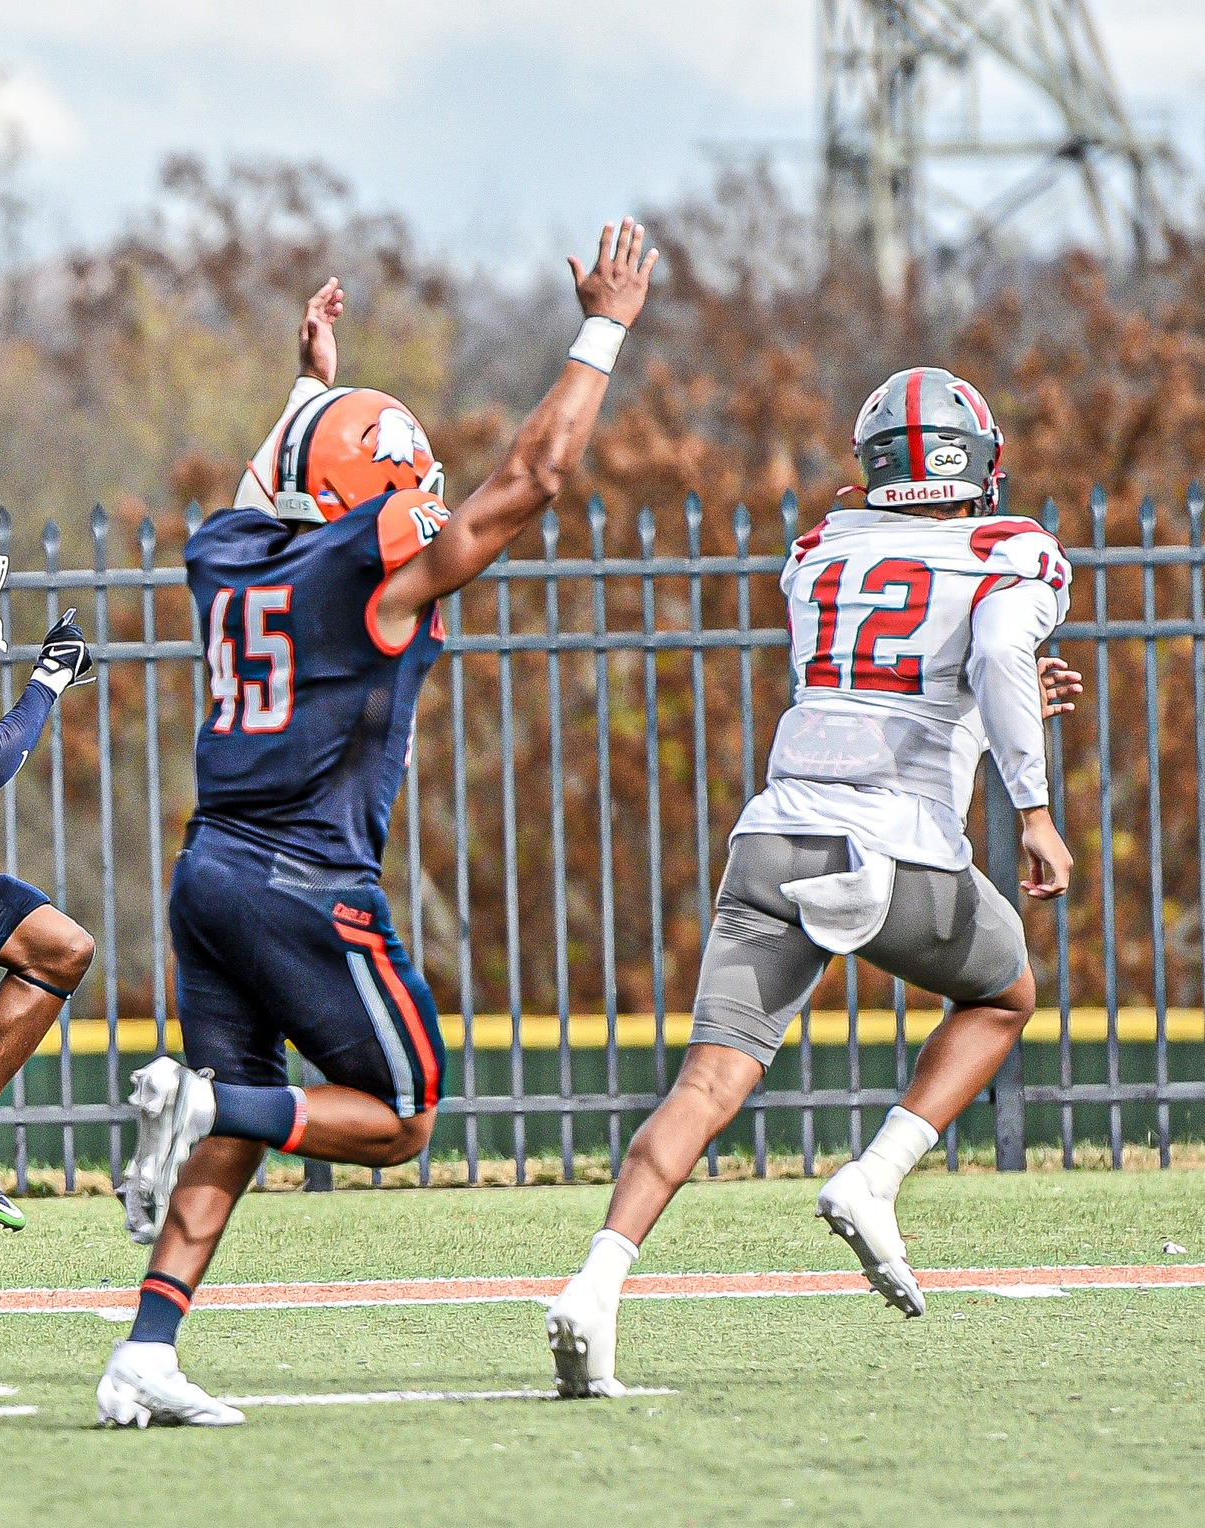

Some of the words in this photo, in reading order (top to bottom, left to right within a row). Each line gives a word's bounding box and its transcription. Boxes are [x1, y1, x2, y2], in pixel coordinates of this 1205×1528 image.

[885, 484, 955, 502] Riddell
[934, 453, 963, 467] SAC
[207, 584, 295, 734] 45
[805, 557, 935, 695] 12
